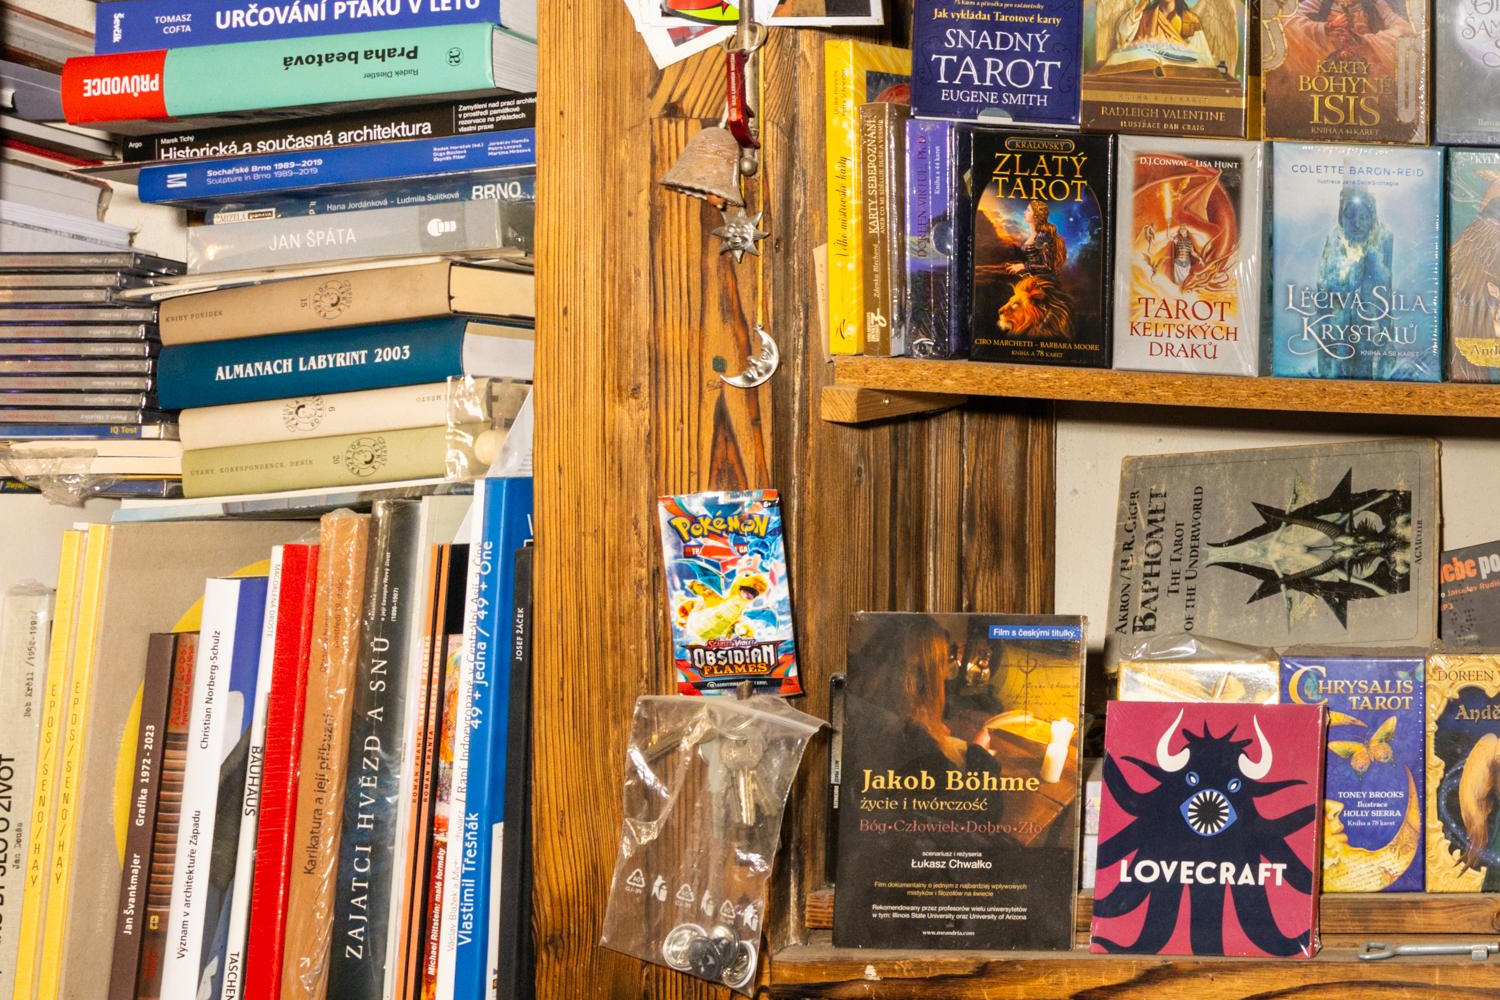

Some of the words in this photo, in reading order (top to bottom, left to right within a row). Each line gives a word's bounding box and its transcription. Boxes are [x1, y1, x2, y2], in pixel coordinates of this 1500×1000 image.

[154, 13, 192, 25] TOMASZ
[162, 23, 192, 35] COFTA
[943, 27, 1051, 51] SNADNÝ
[281, 47, 355, 71] beatová
[358, 44, 419, 64] Praha
[82, 71, 160, 98] PRŮVODCE
[930, 52, 1062, 92] TAROT
[1298, 74, 1393, 96] BOHYNĚ
[941, 89, 998, 105] EUGENE
[1000, 91, 1049, 107] SMITH
[1310, 95, 1381, 126] ISIS
[256, 129, 335, 154] současná
[337, 119, 432, 145] architektura
[992, 151, 1089, 178] ZLATÝ
[992, 177, 1089, 202] TAROT
[269, 233, 301, 251] JAN
[306, 224, 357, 249] ŠPÁTA
[1137, 296, 1232, 323] TAROT
[1129, 321, 1239, 342] KELTSKÝCH
[214, 357, 293, 382] ALMANACH
[298, 350, 369, 376] LABYRINT
[374, 345, 411, 364] 2003
[1148, 340, 1218, 361] DRAKŮ
[514, 606, 525, 633] ŽÁČEK
[992, 627, 1010, 638] Film
[1017, 627, 1048, 640] českými
[514, 636, 524, 662] JOSEF
[204, 629, 222, 702] Norberg-Schulz
[368, 634, 390, 695] SNŮ
[702, 664, 769, 675] FLAMES
[1437, 669, 1494, 682] DOREEN
[1288, 664, 1414, 706] CHRYSALIS
[365, 704, 385, 723] A
[1349, 695, 1414, 711] TAROT
[199, 700, 213, 750] Christian
[243, 745, 263, 818] BAUHAUS
[353, 733, 381, 831] HVĚZD
[861, 769, 935, 794] Jakob
[945, 770, 1040, 792] Böhme
[911, 858, 947, 869] Łukasz
[949, 858, 992, 870] Chwałko
[1119, 859, 1288, 888] LOVECRAFT
[345, 844, 373, 960] ZAJATCI
